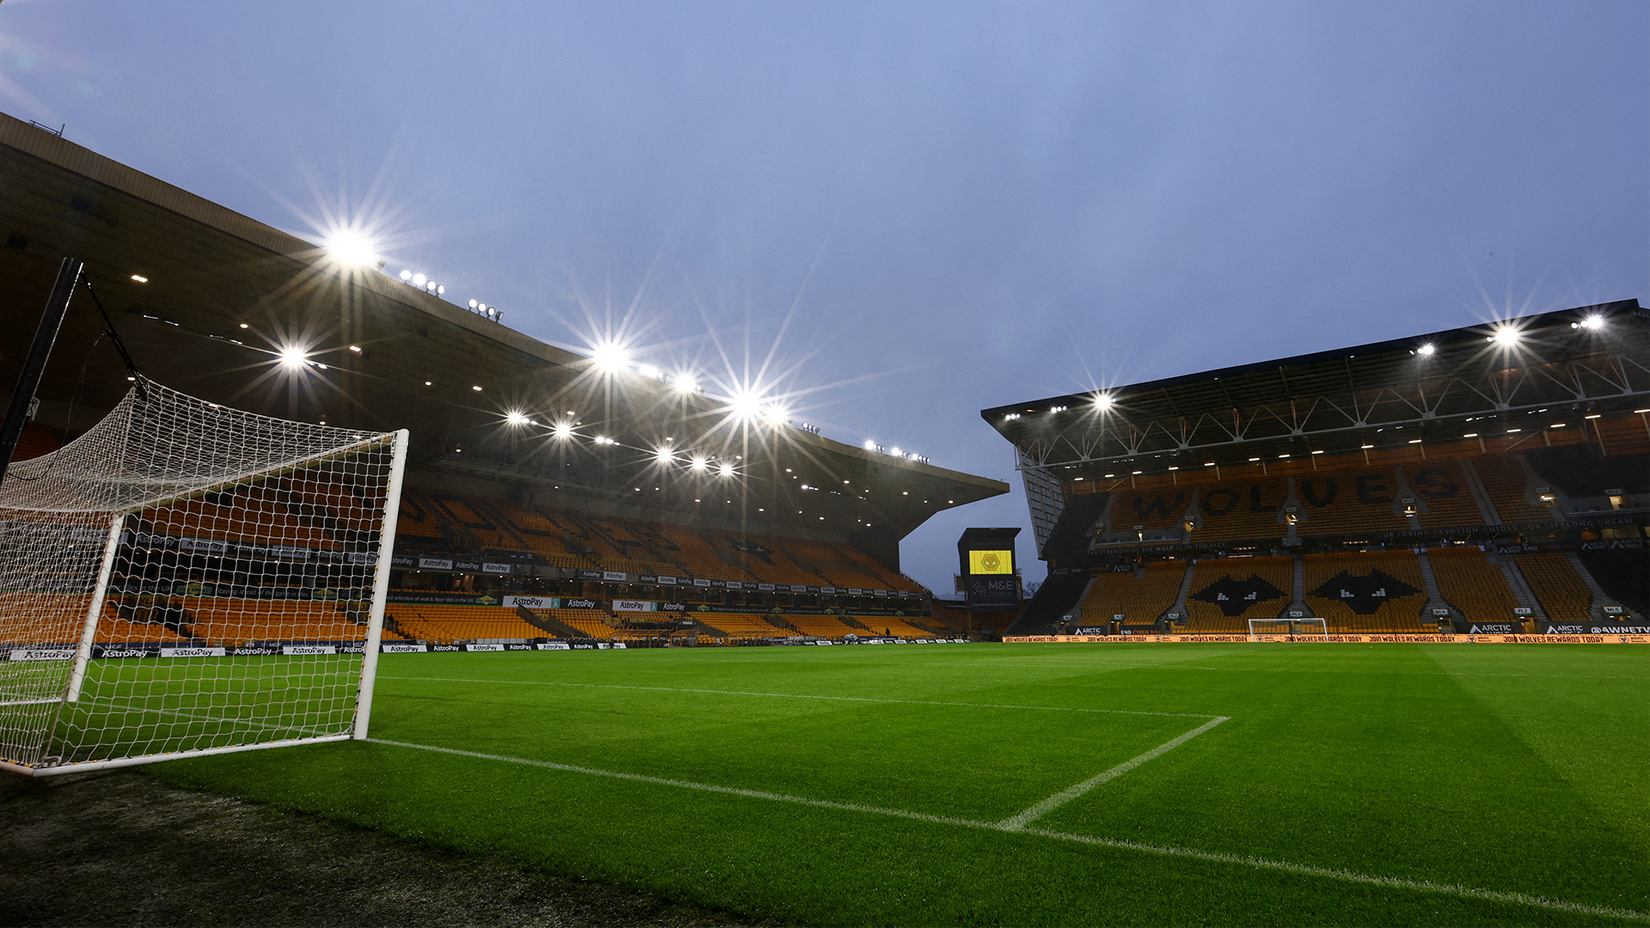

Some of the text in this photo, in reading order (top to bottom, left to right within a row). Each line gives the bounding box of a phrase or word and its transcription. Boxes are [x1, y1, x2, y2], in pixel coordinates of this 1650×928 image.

[1131, 467, 1461, 522] WOLVES
[424, 559, 449, 567] AstroPay
[456, 562, 480, 570] AstroPay
[485, 564, 508, 572] AstroPay
[988, 580, 1013, 590] M&E
[512, 596, 543, 607] AstroPay
[567, 599, 596, 609] AstroPay
[619, 601, 645, 611] AstroPay
[662, 602, 686, 612] AstroPay
[101, 649, 148, 658] AstroPay
[172, 648, 214, 657] AstroPay
[234, 647, 273, 656] AstroPay
[292, 646, 326, 654] AstroPay
